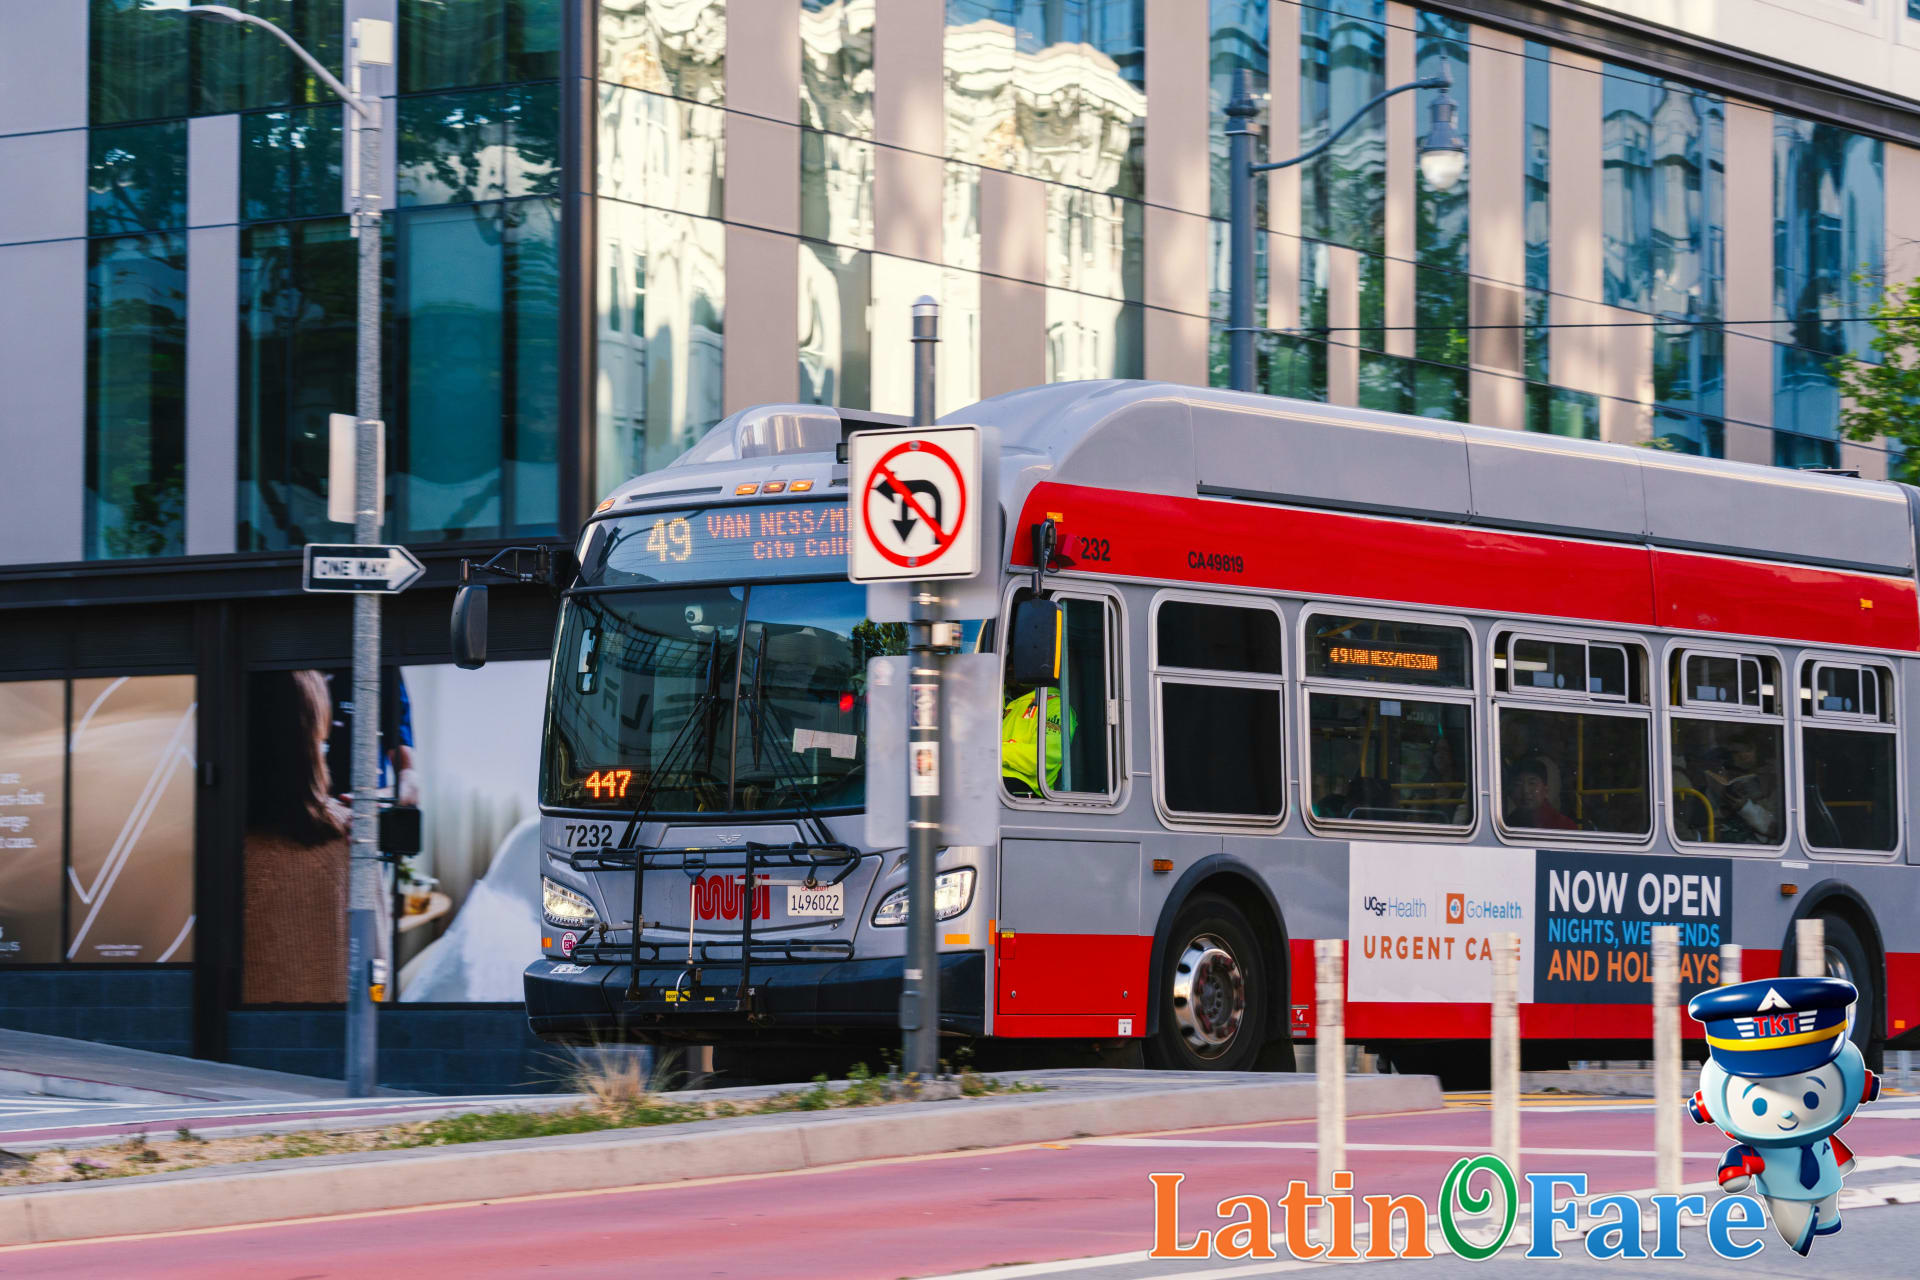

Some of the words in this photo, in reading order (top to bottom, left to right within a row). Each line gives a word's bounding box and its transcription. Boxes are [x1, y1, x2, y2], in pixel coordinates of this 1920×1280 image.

[707, 514, 751, 538] VAN
[647, 517, 692, 562] 49
[753, 540, 796, 560] City
[1079, 537, 1111, 562] 232
[320, 560, 351, 576] ONE
[357, 561, 389, 577] WAY
[1187, 551, 1244, 573] CA49819
[1329, 647, 1349, 663] 49
[1350, 649, 1369, 665] VAN
[1371, 650, 1438, 671] NESS/MISSION
[585, 770, 632, 798] 447
[565, 825, 613, 847] 7232
[791, 894, 840, 911] 1496022
[1549, 869, 1629, 914] NOW
[1637, 872, 1721, 917] OPEN
[1364, 896, 1387, 917] UCSF
[1388, 898, 1427, 918] Health
[1466, 900, 1522, 919] GoHealth
[1549, 918, 1619, 949] NIGHTS,
[1622, 920, 1720, 948] WEENDS
[1364, 935, 1455, 960] URGENT
[1465, 937, 1521, 961] CA
[1547, 949, 1600, 982] AND
[1607, 951, 1720, 985] HOLAYS
